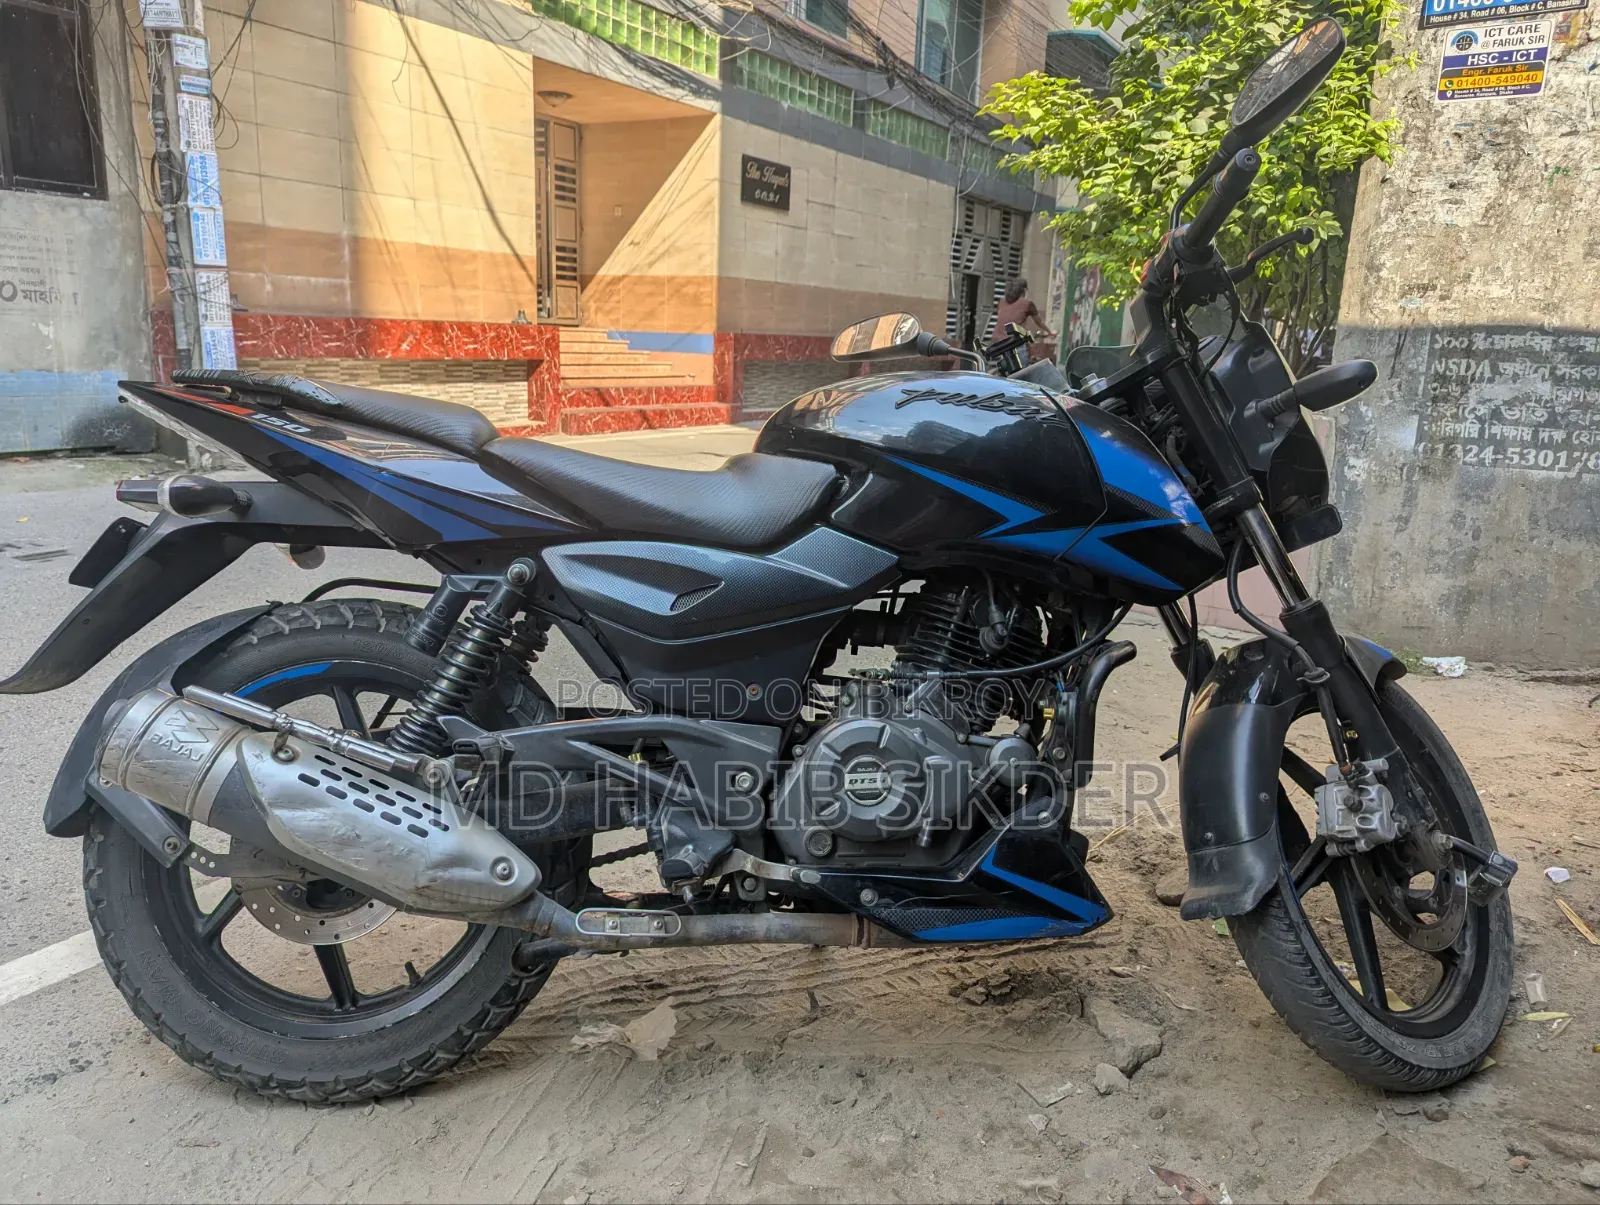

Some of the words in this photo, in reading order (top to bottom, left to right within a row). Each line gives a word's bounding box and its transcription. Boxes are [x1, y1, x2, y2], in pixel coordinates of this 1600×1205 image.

[1429, 14, 1451, 24] House
[1459, 11, 1469, 20] 34,
[1471, 9, 1490, 19] Road
[1497, 6, 1507, 16] 06,
[1509, 4, 1529, 14] Block
[1537, 2, 1545, 10] C,
[1484, 27, 1504, 38] ICT
[1508, 23, 1541, 35] CARE
[1480, 40, 1490, 49] @
[1492, 37, 1526, 48] FARUK
[1527, 34, 1545, 44] SIR
[1467, 52, 1499, 66] HSC
[1512, 49, 1538, 62] ICT
[1461, 68, 1485, 76] Engr.
[1487, 65, 1513, 74] Faruk
[1515, 63, 1528, 72] Sir
[1456, 73, 1538, 88] 01400-549040
[1431, 358, 1492, 378] NSDA
[251, 413, 311, 433] 150
